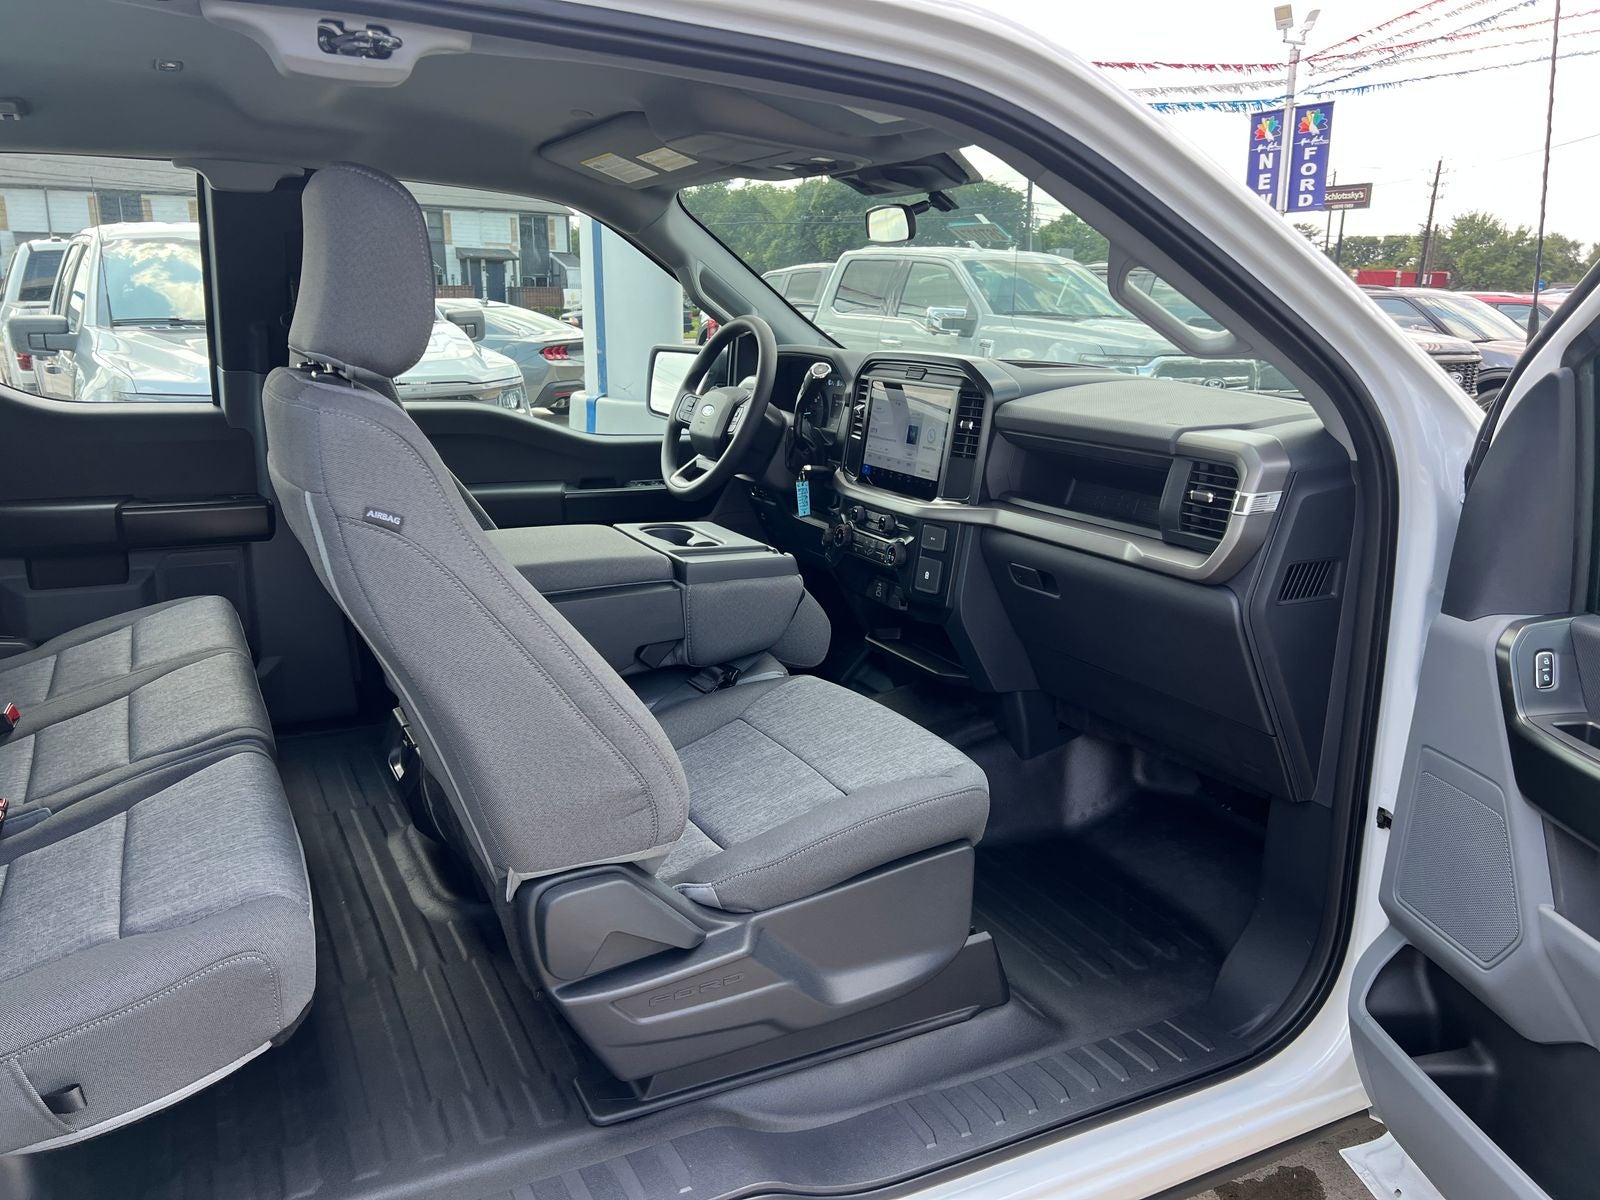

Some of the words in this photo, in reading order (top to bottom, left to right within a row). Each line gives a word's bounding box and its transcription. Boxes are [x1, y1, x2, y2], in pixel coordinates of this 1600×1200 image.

[1298, 146, 1318, 207] FORD
[366, 510, 401, 525] AIRBAG
[649, 971, 745, 1008] FORD
